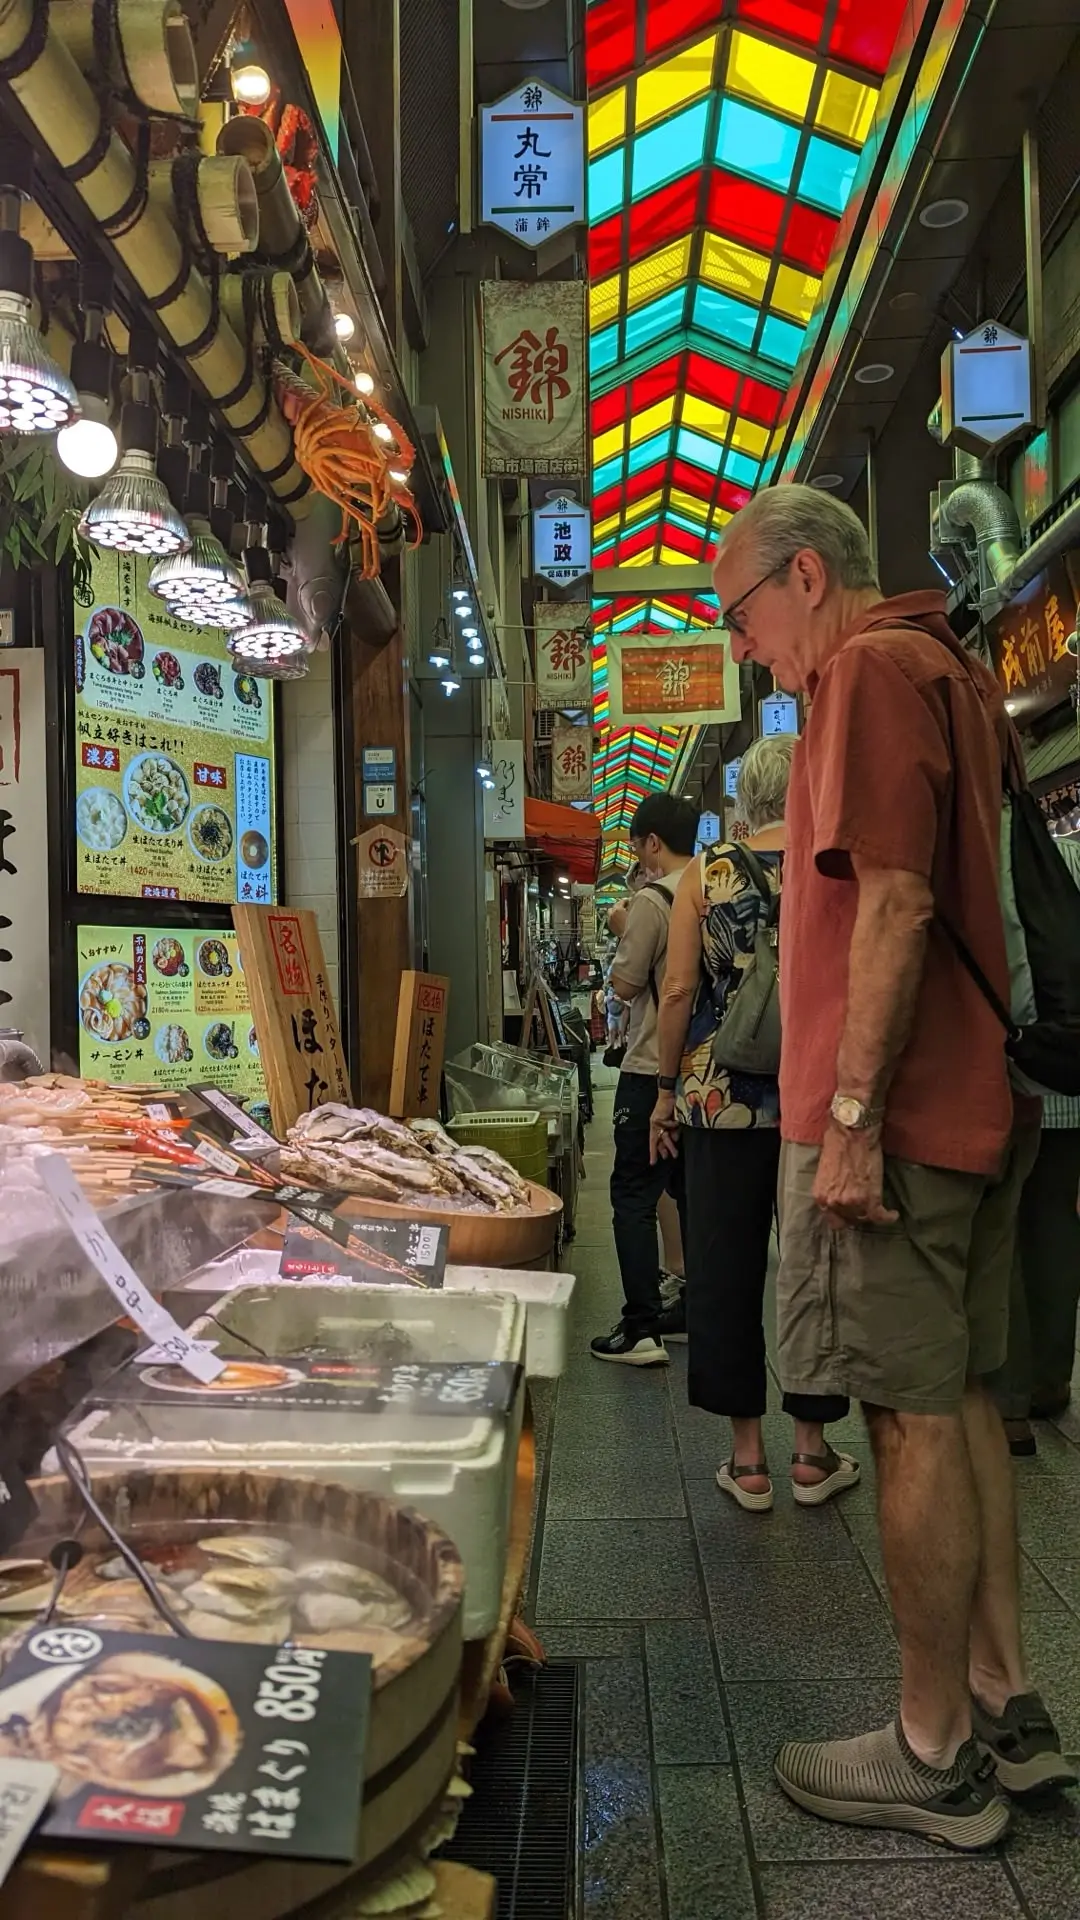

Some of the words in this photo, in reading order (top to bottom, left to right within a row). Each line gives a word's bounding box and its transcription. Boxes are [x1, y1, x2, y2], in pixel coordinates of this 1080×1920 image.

[520, 86, 543, 112] 錦
[513, 126, 552, 199] 丸常
[515, 217, 550, 233] 蒲鉾
[494, 326, 571, 425] 錦
[502, 407, 546, 420] NISHIKI
[490, 458, 578, 475] 錦市場商店街
[553, 521, 572, 562] 池政
[542, 630, 586, 681] 錦
[656, 658, 690, 702] 錦
[86, 745, 115, 769] 濃厚
[556, 744, 587, 782] 錦
[196, 767, 223, 786] 甘味
[84, 854, 128, 865] 生ほたて丼
[240, 881, 268, 901] 無料
[88, 945, 117, 957] おすすめ
[135, 936, 145, 983] 不動の人気
[279, 925, 304, 987] 名物
[90, 1048, 144, 1061] サーモン丼
[254, 1648, 328, 1722] 850円
[247, 1738, 310, 1839] はまぐり
